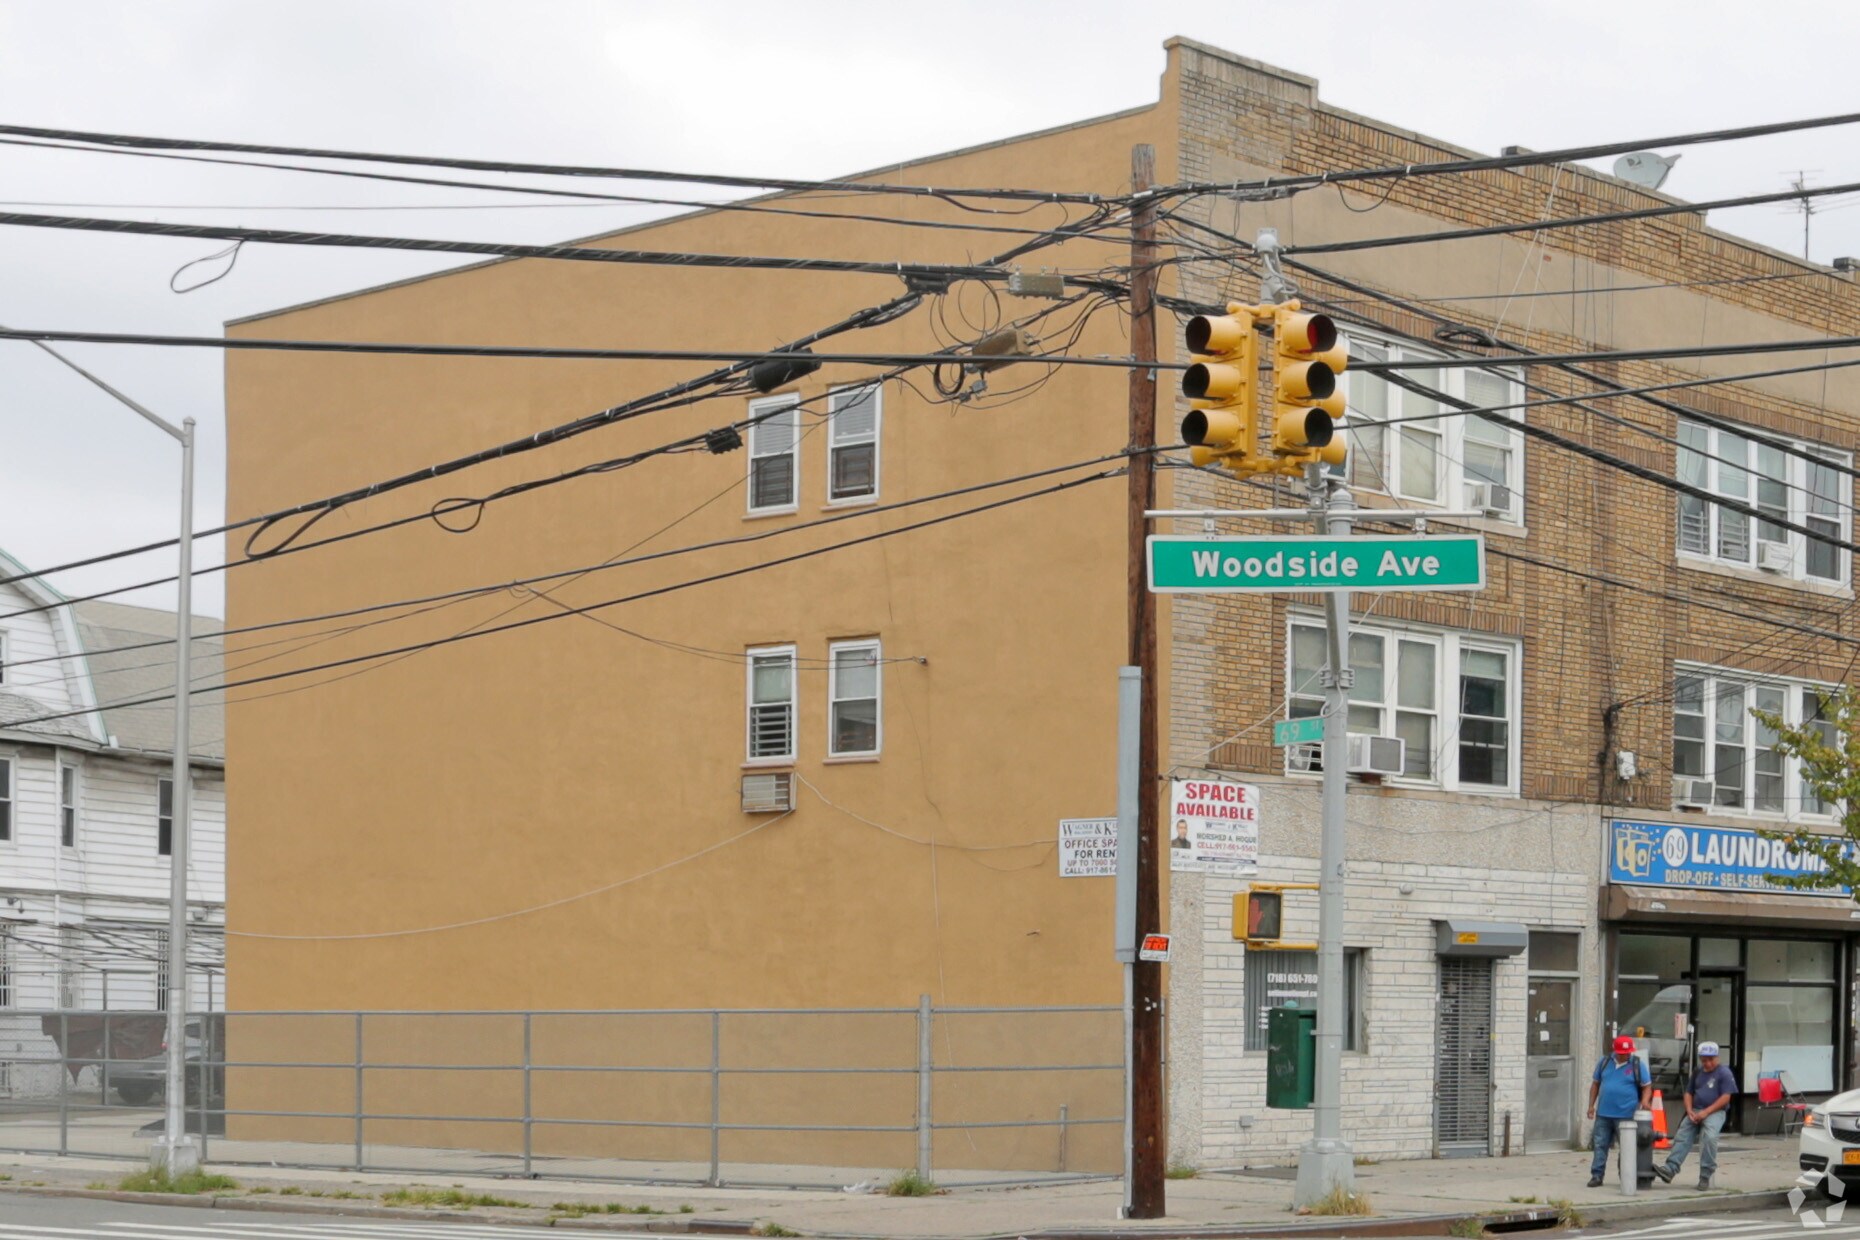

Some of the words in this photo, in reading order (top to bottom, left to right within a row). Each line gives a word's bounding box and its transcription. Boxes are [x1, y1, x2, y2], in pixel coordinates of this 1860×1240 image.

[1192, 550, 1359, 578] Woodside
[1376, 549, 1441, 577] Ave
[1185, 782, 1246, 803] SPACE
[1176, 802, 1255, 821] AVAILABLE
[1064, 839, 1099, 849] OFFICE
[1666, 834, 1686, 860] 69
[1691, 831, 1847, 872] LAUNDROM
[1067, 859, 1077, 867] UP
[1080, 859, 1089, 867] TO
[1074, 849, 1093, 859] FOR
[1665, 868, 1714, 886] DROP-OFF
